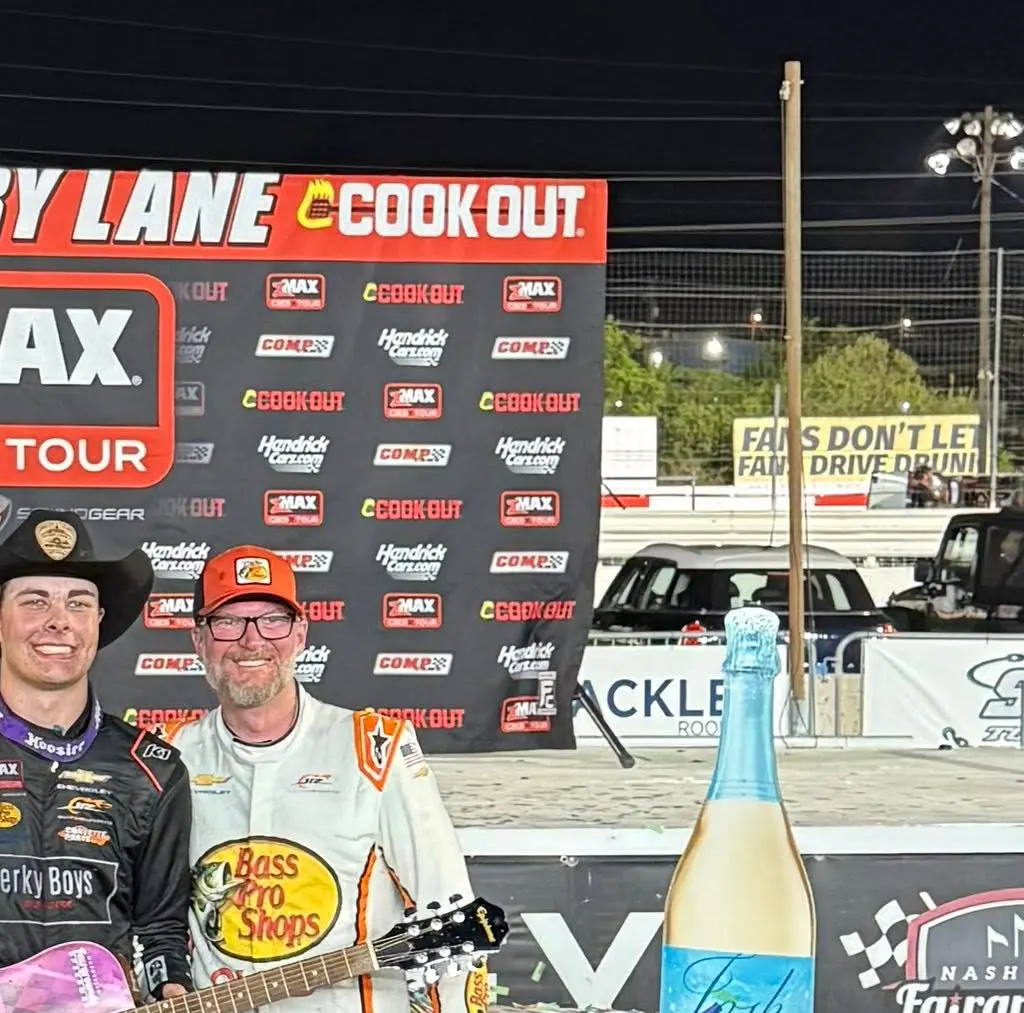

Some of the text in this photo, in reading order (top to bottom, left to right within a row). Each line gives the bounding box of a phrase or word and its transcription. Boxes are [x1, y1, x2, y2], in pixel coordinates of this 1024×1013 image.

[72, 168, 280, 247] LANE
[339, 182, 585, 239] COOK OUT
[378, 283, 465, 304] COOK OUT
[827, 422, 925, 452] DON'T
[5, 438, 147, 472] TOUR
[380, 447, 432, 463] COMP
[810, 454, 887, 476] DRIVE
[141, 657, 194, 670] COMP
[234, 847, 299, 879] Bass
[48, 866, 94, 899] Boys
[235, 879, 286, 910] Pro
[238, 907, 321, 948] Shops
